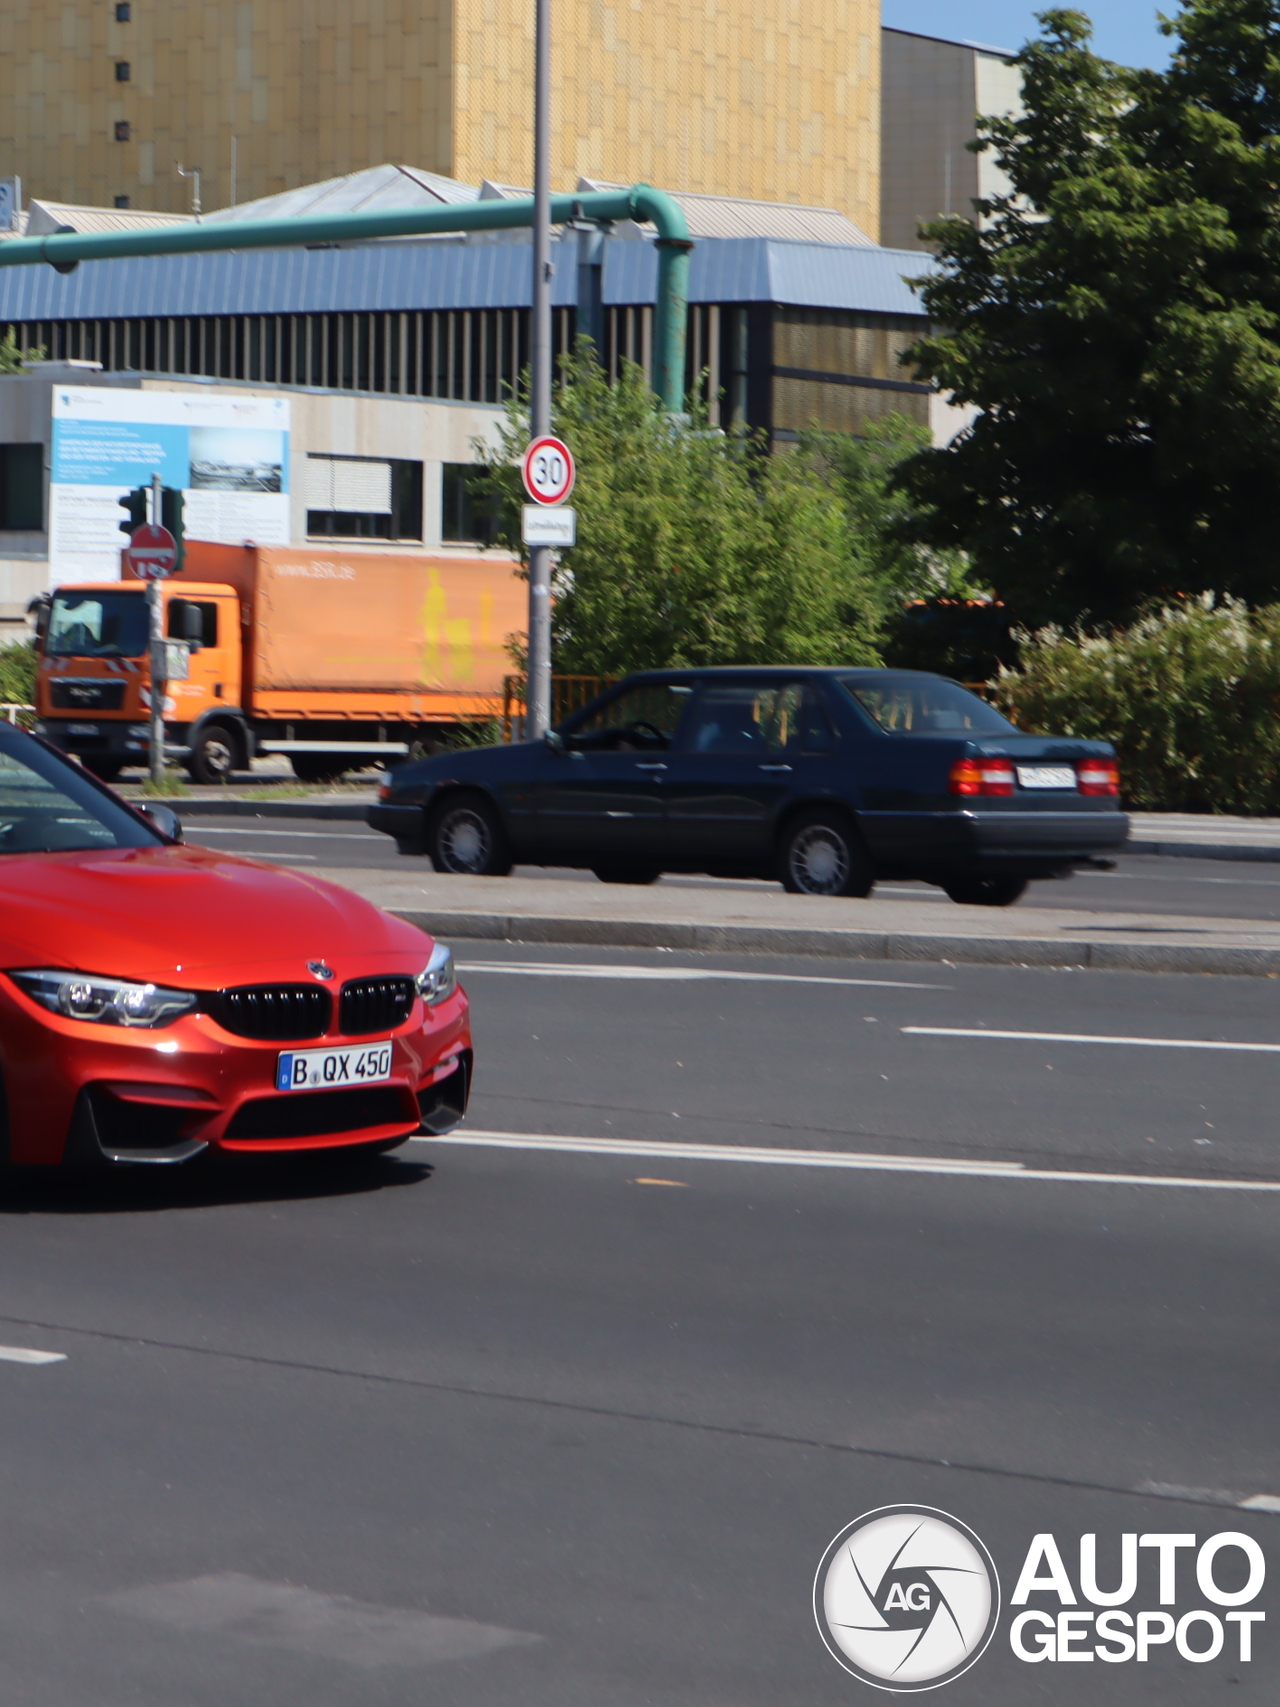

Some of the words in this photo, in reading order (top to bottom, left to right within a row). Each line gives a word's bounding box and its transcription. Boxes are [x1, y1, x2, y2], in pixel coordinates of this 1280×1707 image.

[534, 455, 563, 485] 30
[293, 1059, 308, 1085] B
[323, 1054, 350, 1082] QX
[354, 1049, 390, 1078] 450
